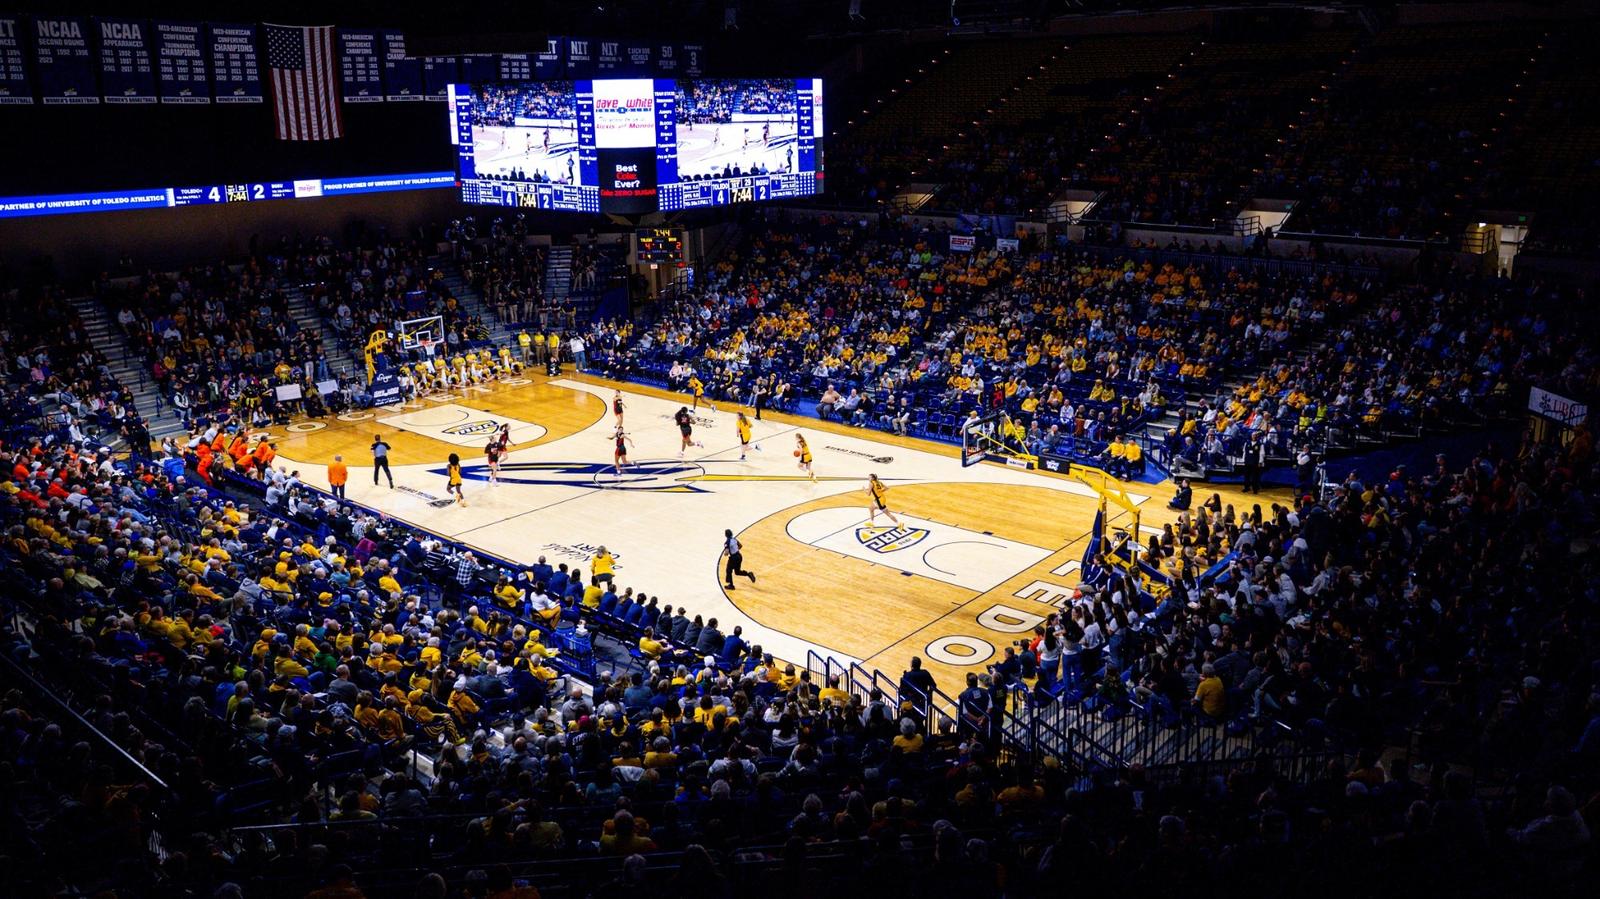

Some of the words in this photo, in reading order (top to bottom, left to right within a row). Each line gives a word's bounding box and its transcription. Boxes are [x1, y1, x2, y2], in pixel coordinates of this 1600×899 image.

[0, 20, 15, 38] IT
[37, 20, 81, 38] NCAA
[101, 22, 141, 39] NCAA
[158, 24, 198, 33] MID-AMERICAN
[212, 28, 251, 36] MID-AMERICAN
[38, 38, 62, 46] SECOND
[63, 39, 85, 47] ROUND
[162, 33, 195, 41] CONFERENCE
[217, 36, 248, 44] CONFERENCE
[103, 39, 144, 47] APPEARANCES
[213, 43, 254, 53] CHAMPIONS
[570, 40, 588, 55] NIT
[160, 48, 201, 57] CHAMPIONS
[601, 42, 619, 56] NIT
[661, 45, 673, 58] 50
[690, 51, 697, 66] 3
[615, 164, 638, 172] Best
[614, 180, 640, 188] Ever?
[744, 178, 751, 186] 29
[208, 187, 220, 202] 4
[253, 184, 265, 199] 2
[298, 185, 316, 193] meijer
[759, 186, 766, 200] 2
[228, 192, 246, 202] 7:44
[507, 192, 512, 206] 4
[519, 194, 537, 207] 7:44
[718, 190, 724, 204] 4
[732, 187, 752, 203] 7:44
[47, 200, 90, 208] UNIVERSITY
[130, 195, 165, 203] ATHLETICS
[543, 195, 549, 208] 2
[676, 241, 682, 250] 2
[951, 238, 974, 246] ESPN
[376, 373, 393, 383] Kroger
